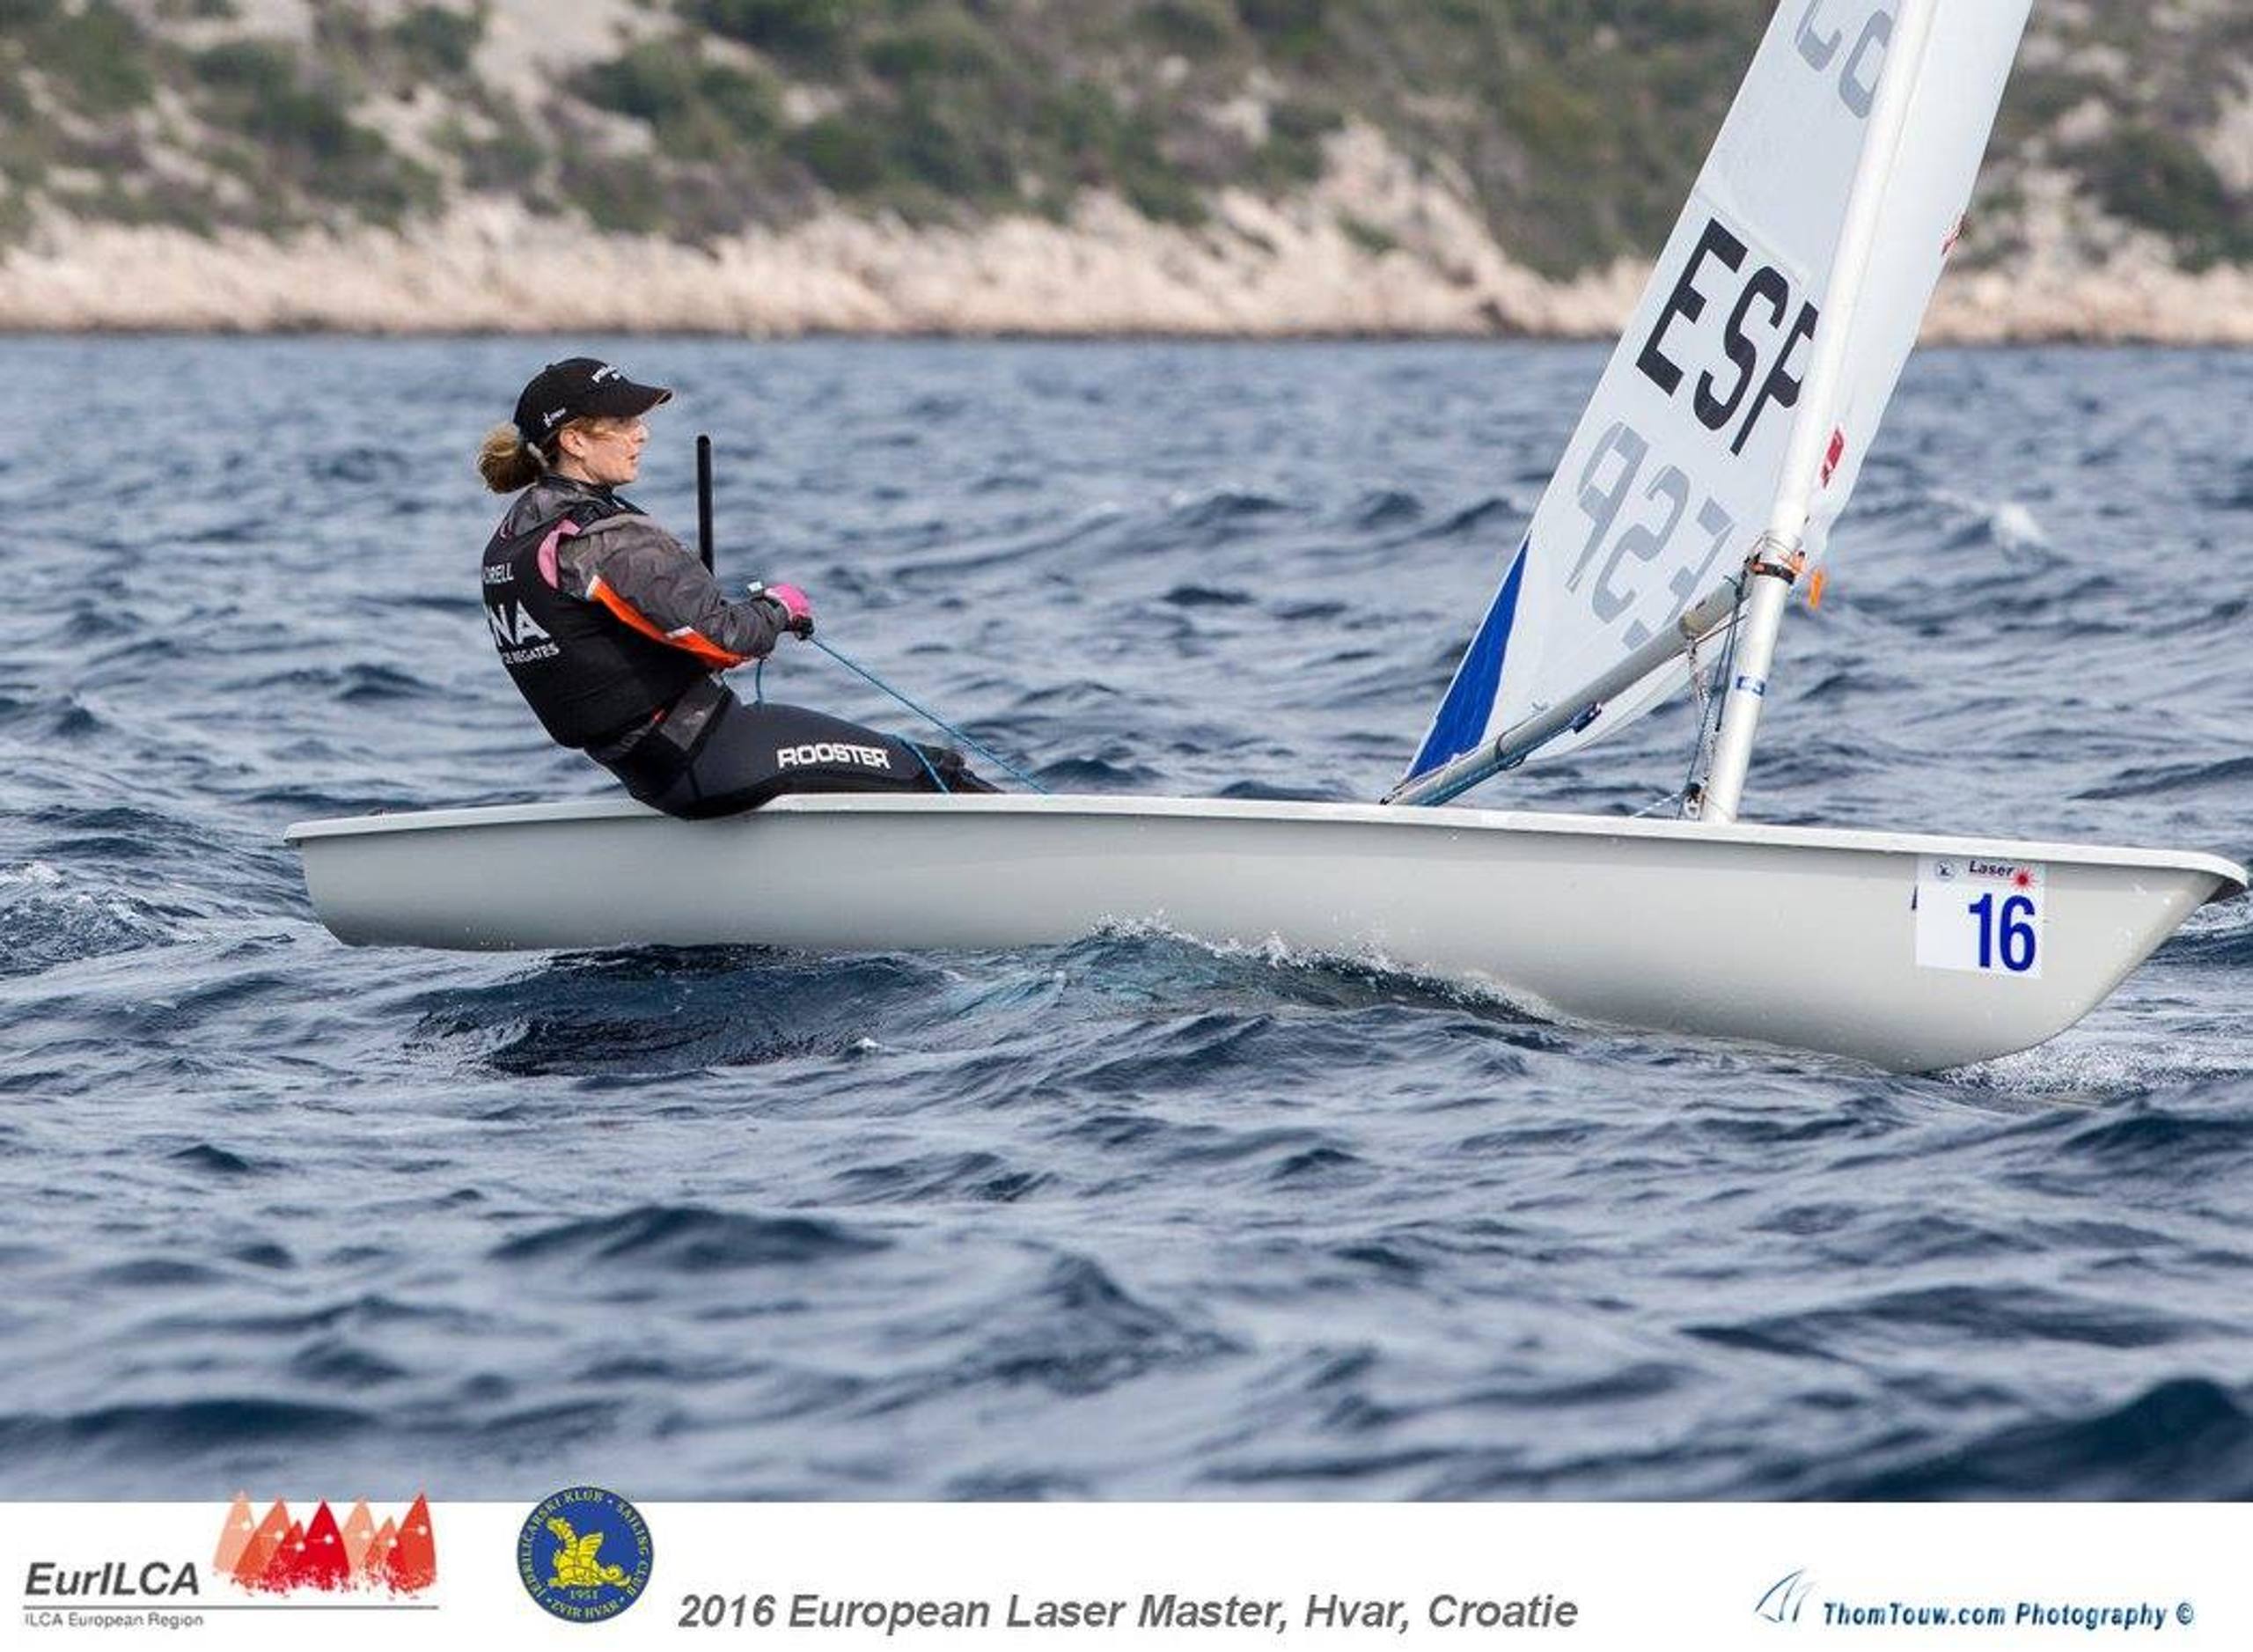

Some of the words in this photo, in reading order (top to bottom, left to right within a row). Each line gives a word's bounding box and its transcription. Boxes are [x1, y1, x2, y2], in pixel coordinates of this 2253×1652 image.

[1635, 217, 1819, 457] ESP
[776, 742, 892, 770] ROOSTER
[1969, 859, 2014, 877] Laser
[1968, 892, 2036, 972] 16
